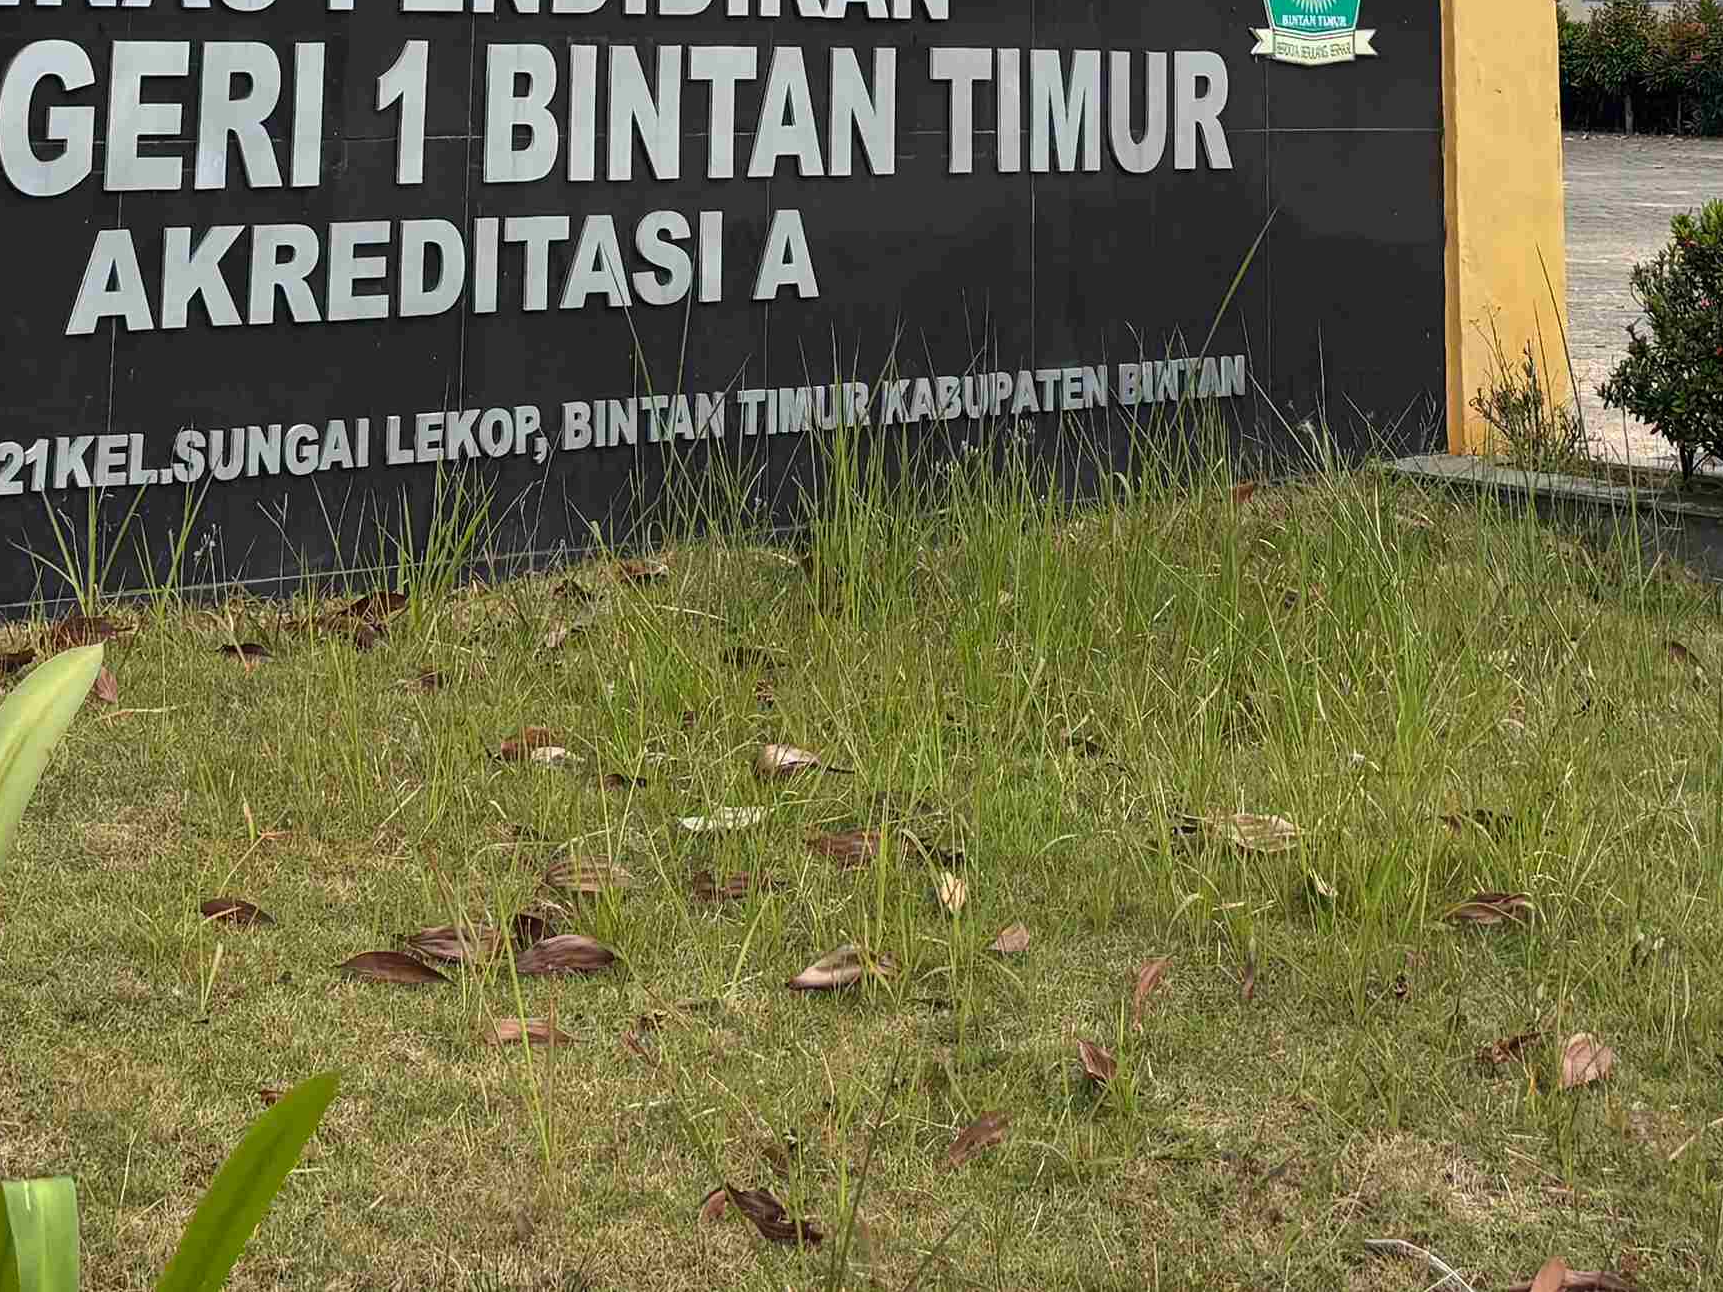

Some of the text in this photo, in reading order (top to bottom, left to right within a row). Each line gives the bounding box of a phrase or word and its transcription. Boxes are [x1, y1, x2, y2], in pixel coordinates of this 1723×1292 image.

[379, 41, 428, 183] 1
[486, 44, 896, 182] BINTAN
[933, 48, 1232, 172] TIMUR
[66, 210, 818, 335] AKREDITASI A
[389, 406, 547, 464] LEKOP,
[565, 394, 724, 449] BINTAN
[741, 382, 868, 434] TIMUR
[884, 365, 1107, 425] KABUPATEN
[1121, 356, 1244, 404] BINTAN
